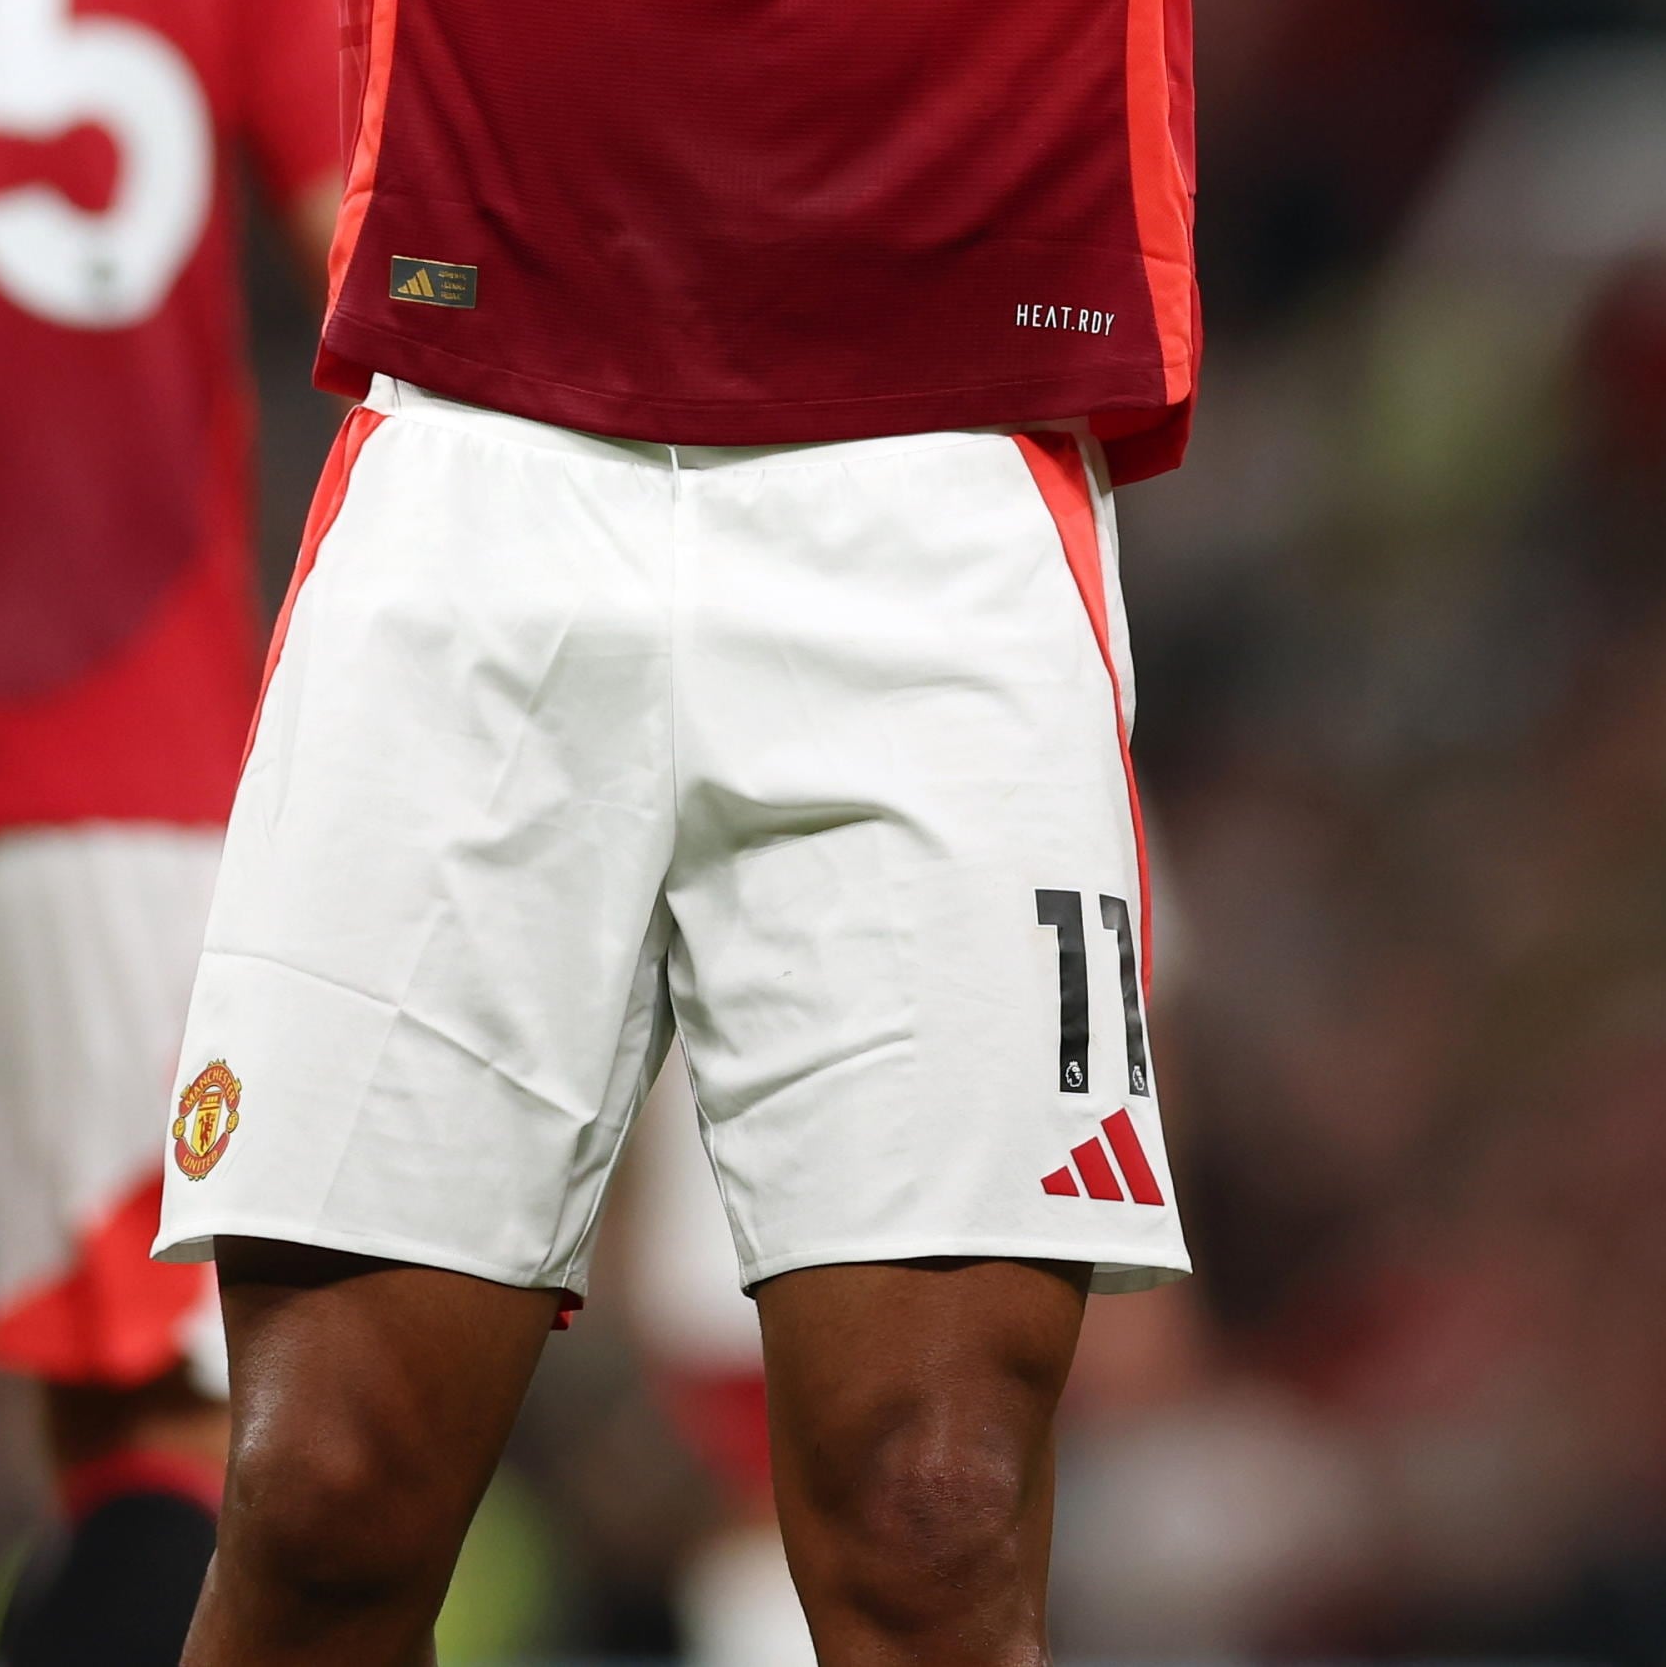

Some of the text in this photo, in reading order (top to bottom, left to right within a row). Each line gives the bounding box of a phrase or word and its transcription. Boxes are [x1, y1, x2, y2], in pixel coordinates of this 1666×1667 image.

[1015, 303, 1115, 337] HEAT.RDY
[1034, 888, 1151, 1098] 11
[184, 1068, 237, 1108] MANCHESTER
[182, 1150, 219, 1172] UNITED
